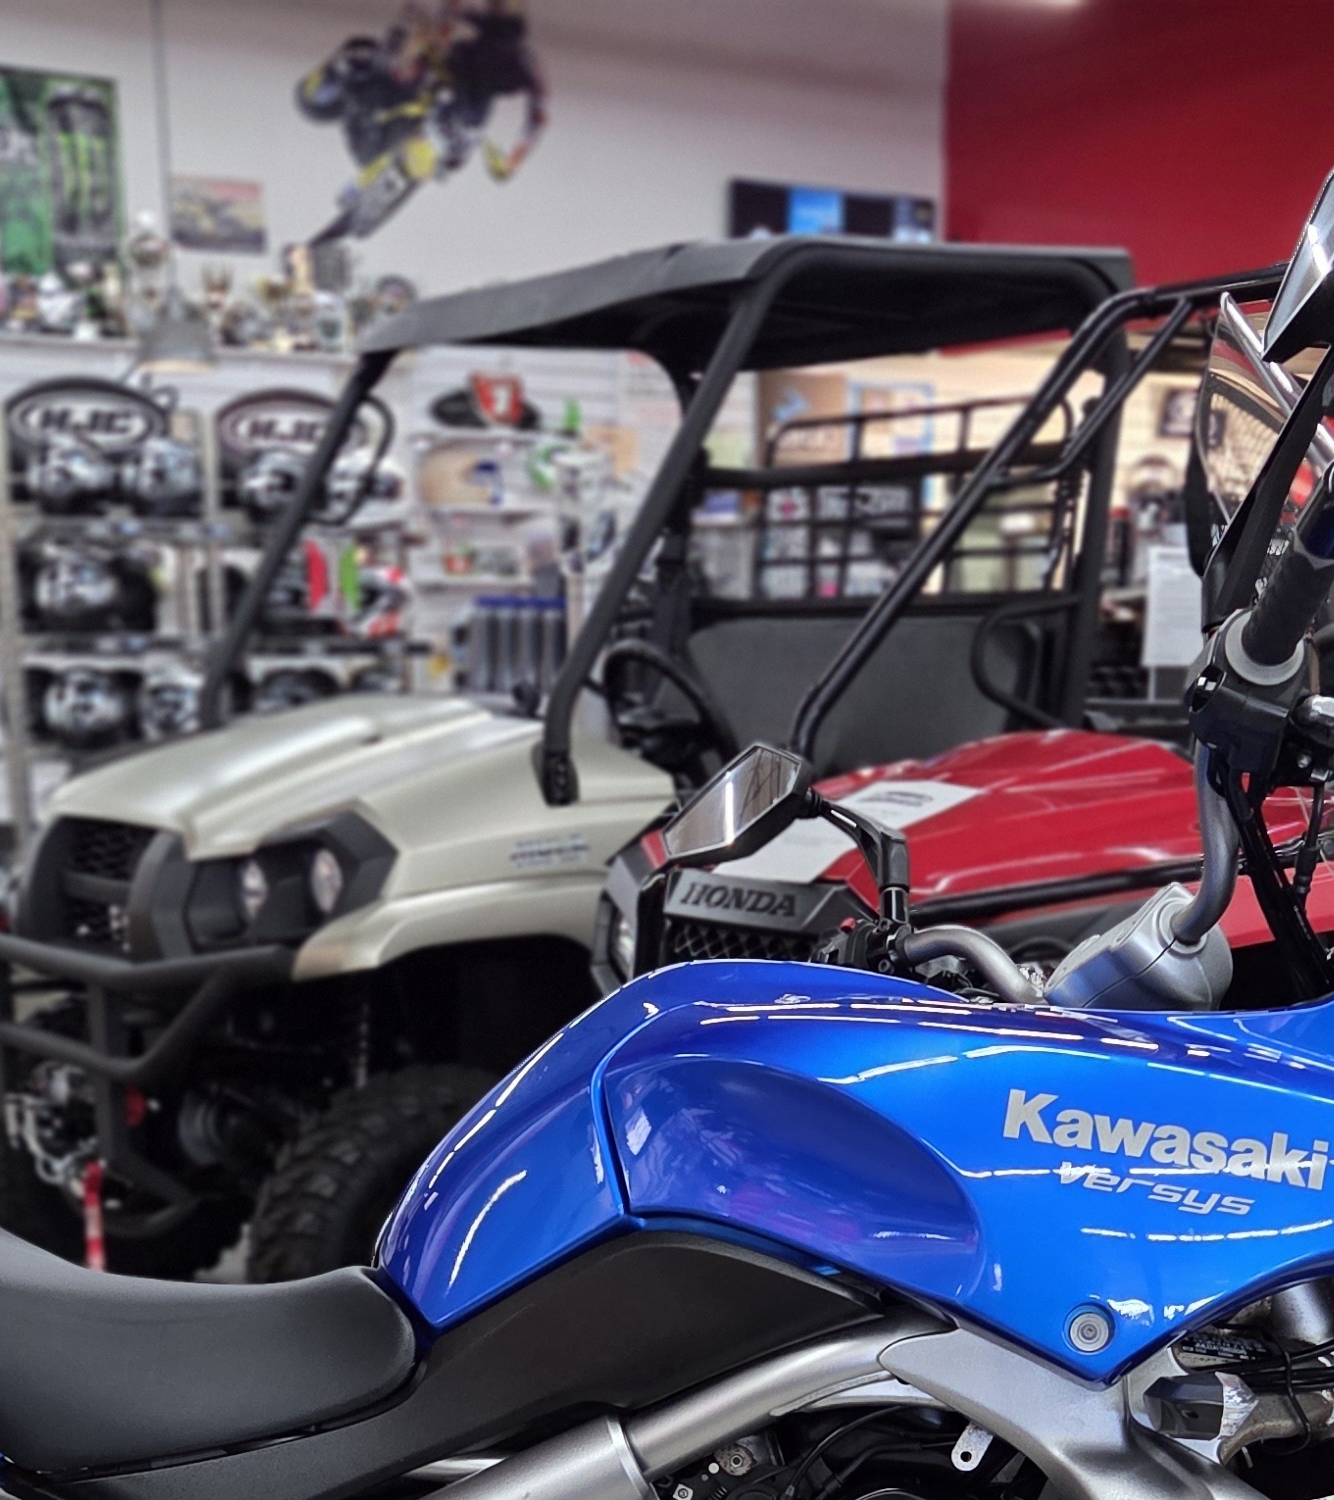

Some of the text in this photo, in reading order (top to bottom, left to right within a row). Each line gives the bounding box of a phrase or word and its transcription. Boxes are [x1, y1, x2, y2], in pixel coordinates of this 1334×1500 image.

[41, 408, 132, 434] HJC
[680, 883, 798, 917] HONDA
[1002, 1088, 1330, 1191] Kawasaki
